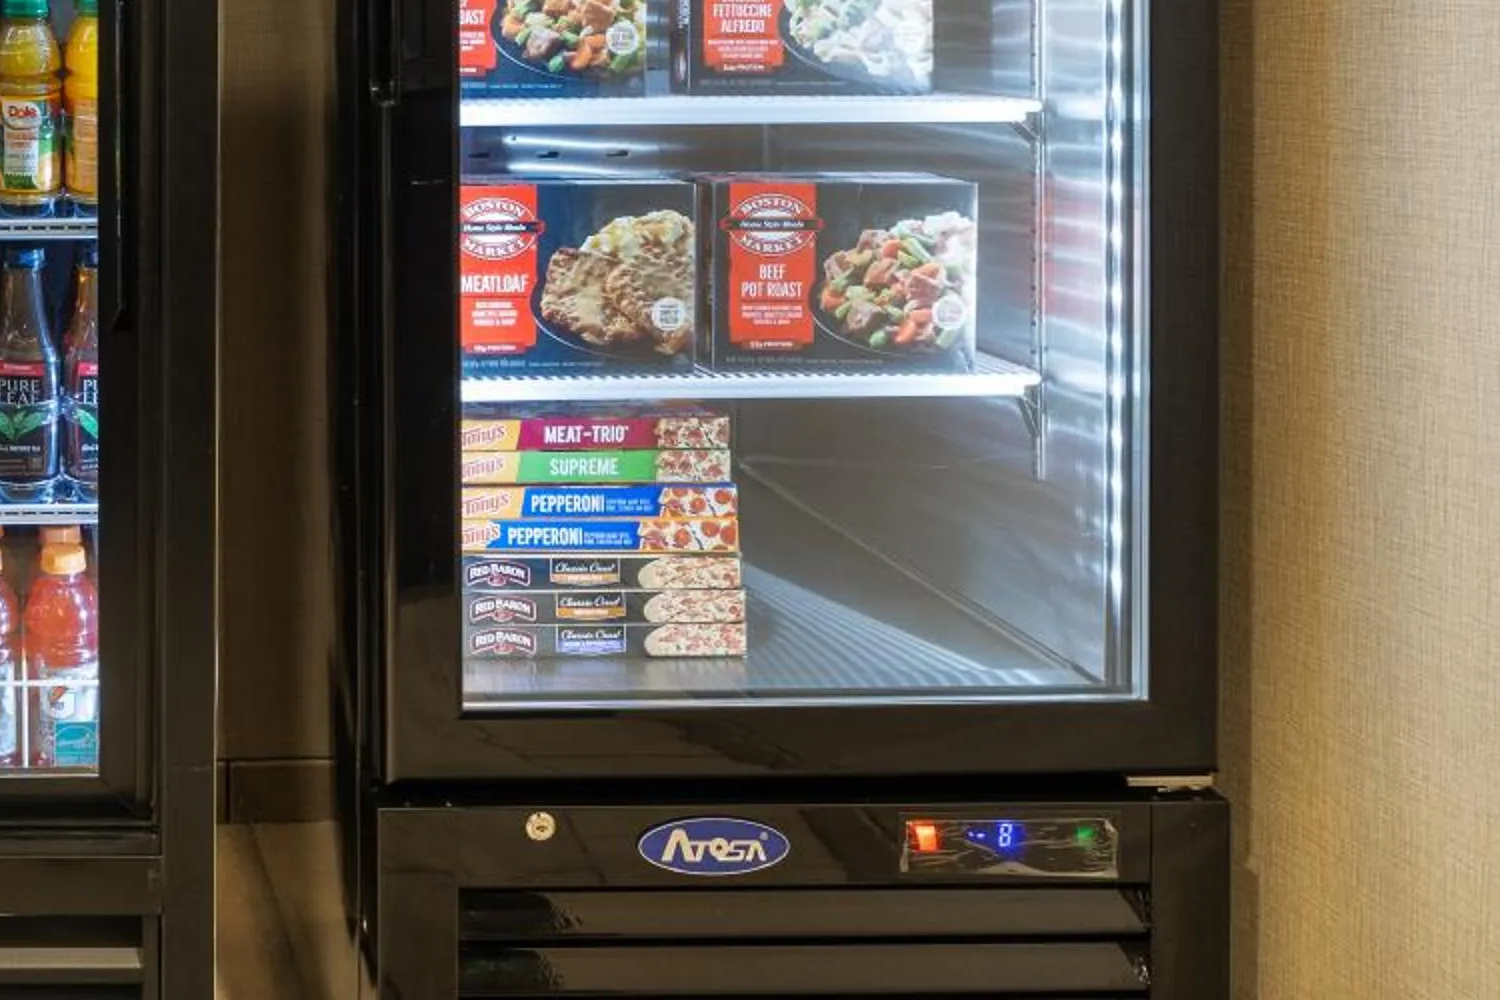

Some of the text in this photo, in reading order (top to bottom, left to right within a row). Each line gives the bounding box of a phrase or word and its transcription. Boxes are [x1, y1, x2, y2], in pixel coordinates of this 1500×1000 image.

[713, 3, 773, 18] FETTUCCINE
[721, 18, 765, 33] ALFREDO
[7, 105, 37, 118] Dole
[465, 201, 525, 217] BOSTON
[740, 199, 803, 215] BOSTON
[465, 237, 525, 256] MARKET
[741, 235, 803, 253] MARKET
[759, 264, 787, 280] BEEF
[461, 274, 529, 293] MEATLOAF
[741, 281, 803, 297] POT ROAST
[543, 425, 626, 444] MEAT-TRIO
[550, 458, 620, 477] SUPREME
[531, 494, 605, 513] PEPPERONI
[507, 527, 583, 546] PEPPERONI
[469, 563, 526, 579] RED BARON
[475, 598, 532, 615] RED BARON
[475, 631, 532, 647] RED BARON
[661, 828, 767, 862] ATOSA
